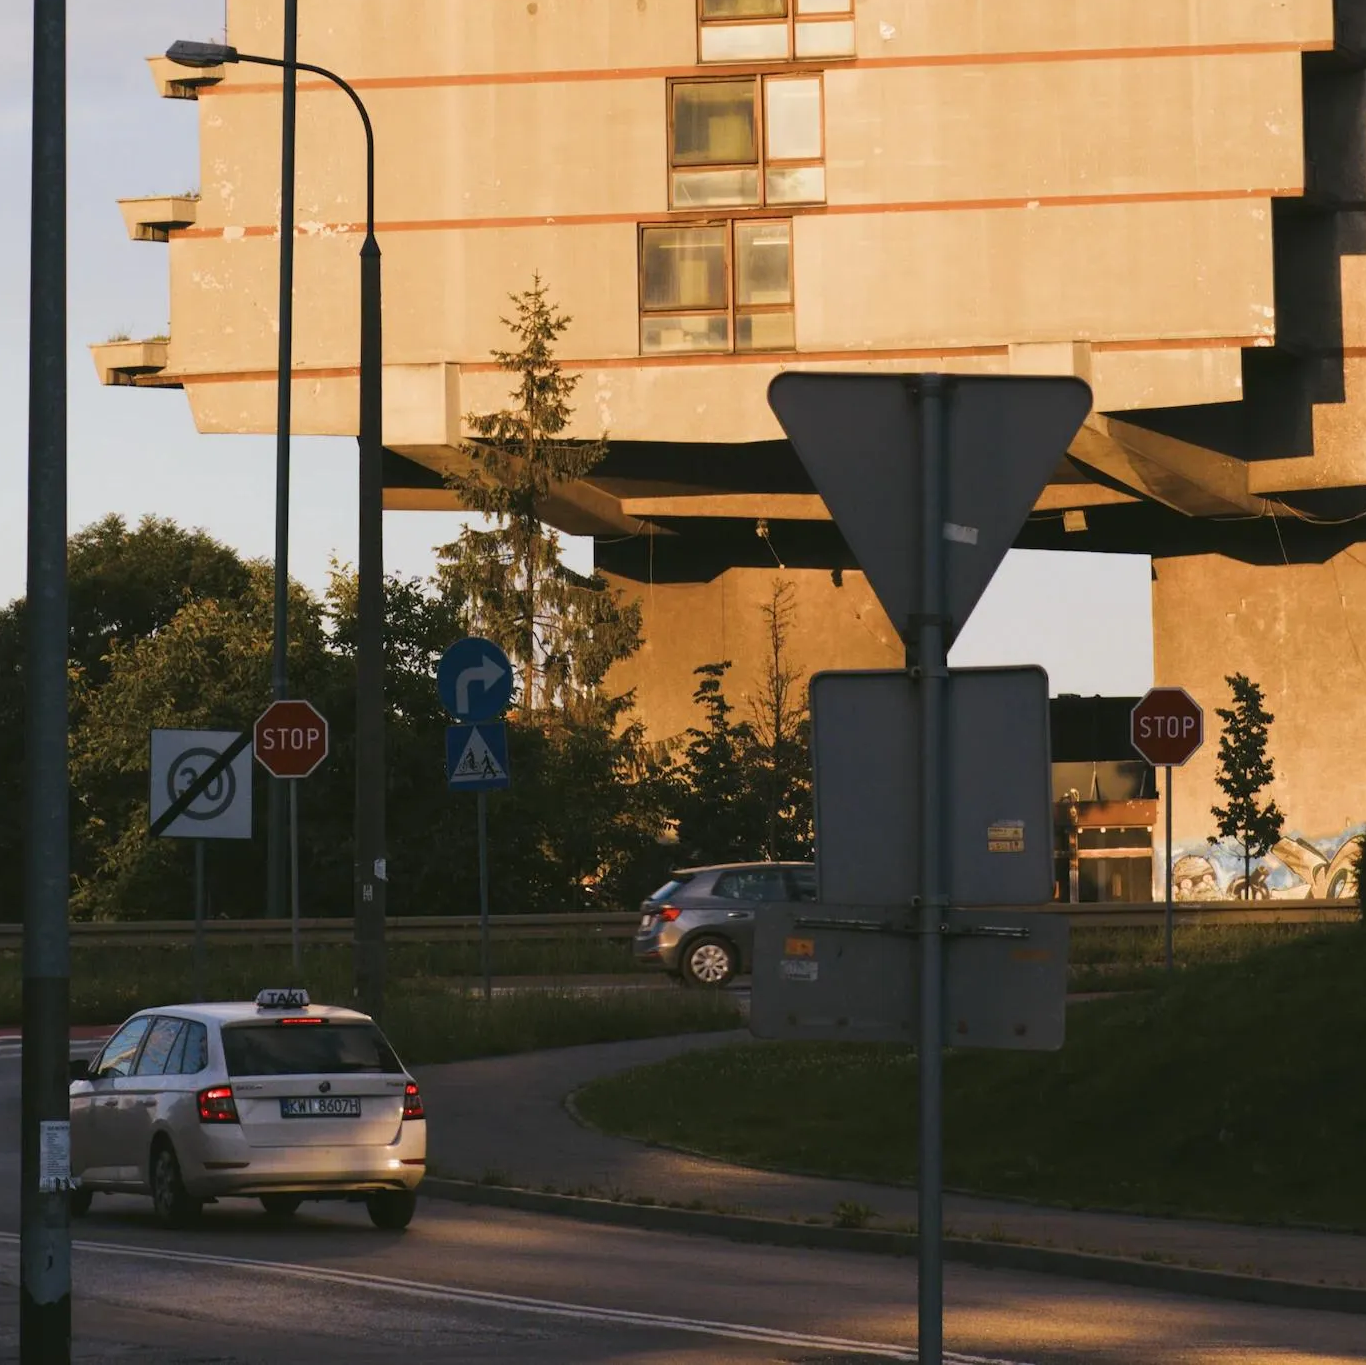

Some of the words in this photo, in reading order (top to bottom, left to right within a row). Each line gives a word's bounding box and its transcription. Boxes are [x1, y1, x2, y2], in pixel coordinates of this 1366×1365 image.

[262, 727, 320, 751] STOP
[1139, 715, 1195, 739] STOP
[179, 766, 224, 801] 30
[267, 992, 304, 1005] TAXI
[289, 1099, 312, 1113] KWI
